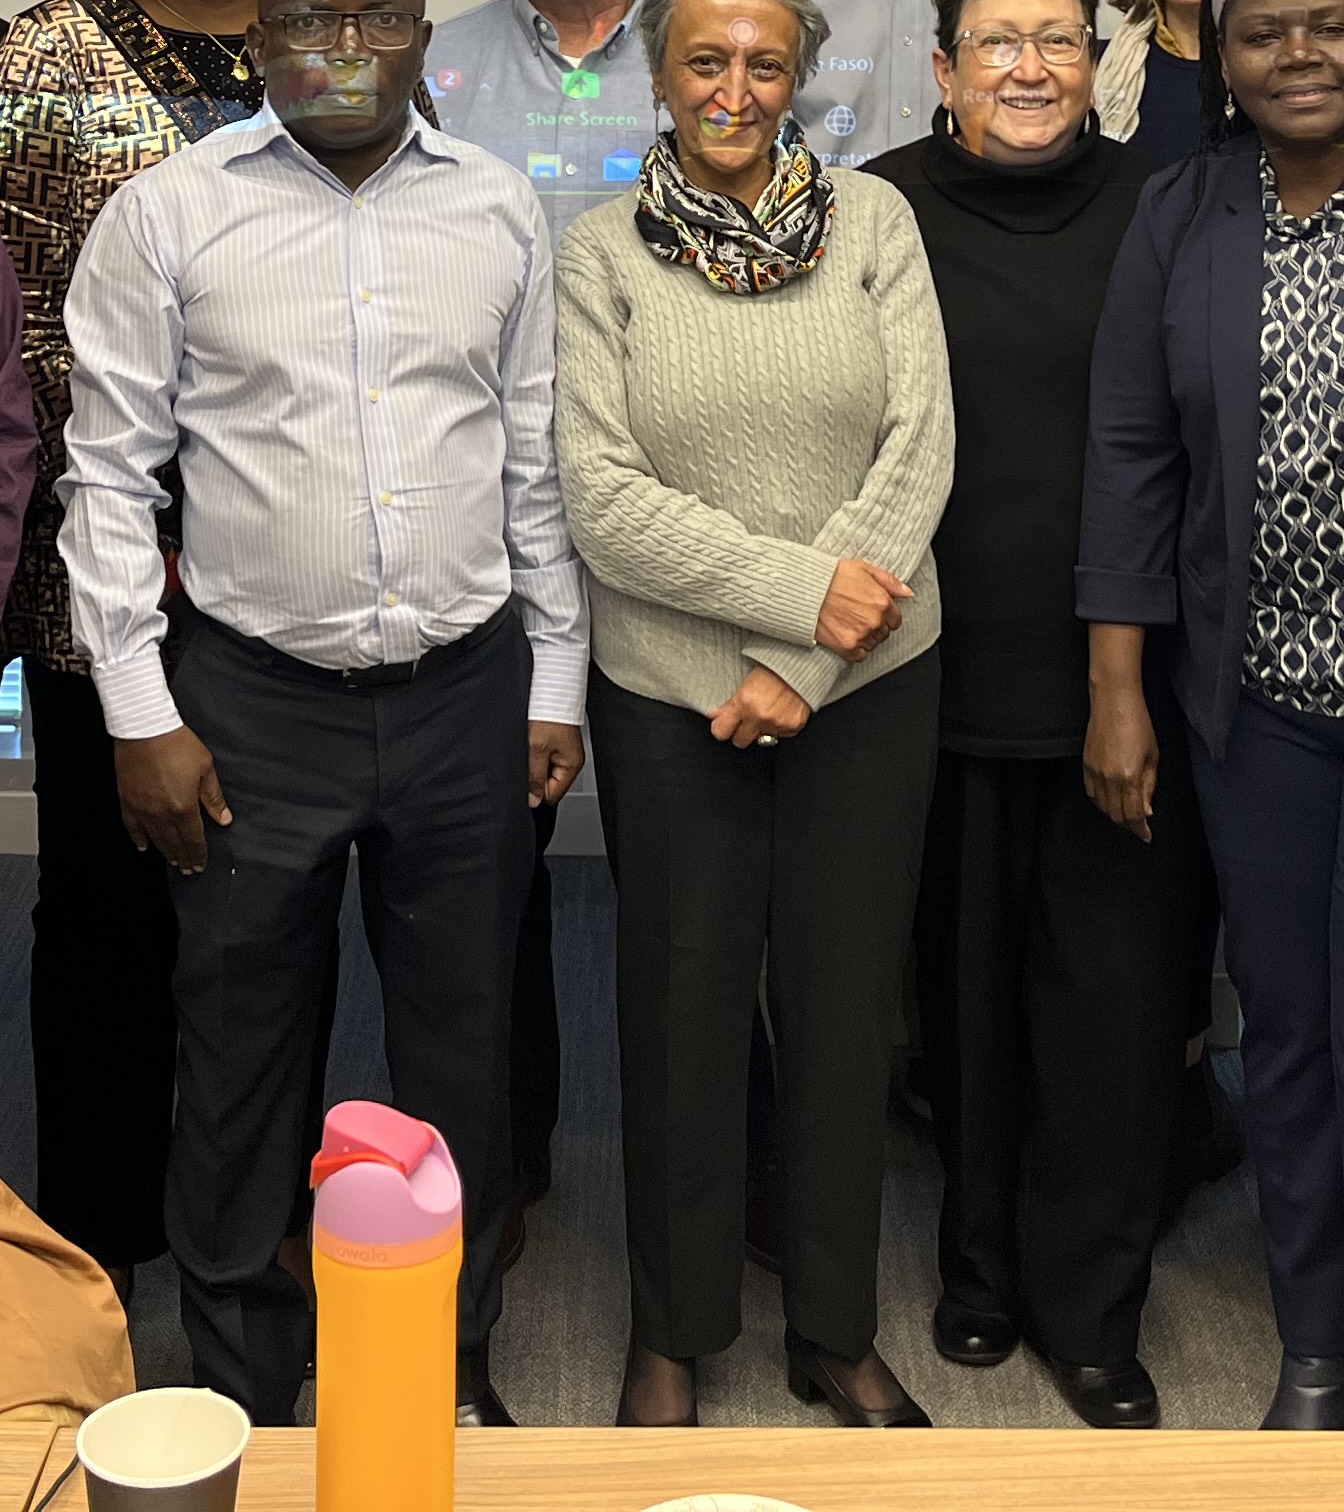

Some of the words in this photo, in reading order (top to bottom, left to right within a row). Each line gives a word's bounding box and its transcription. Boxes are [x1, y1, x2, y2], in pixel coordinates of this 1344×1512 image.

[830, 55, 874, 74] Faso)
[445, 71, 455, 86] 2
[526, 111, 574, 126] Share
[580, 111, 638, 126] Screen
[336, 1246, 388, 1263] owala
